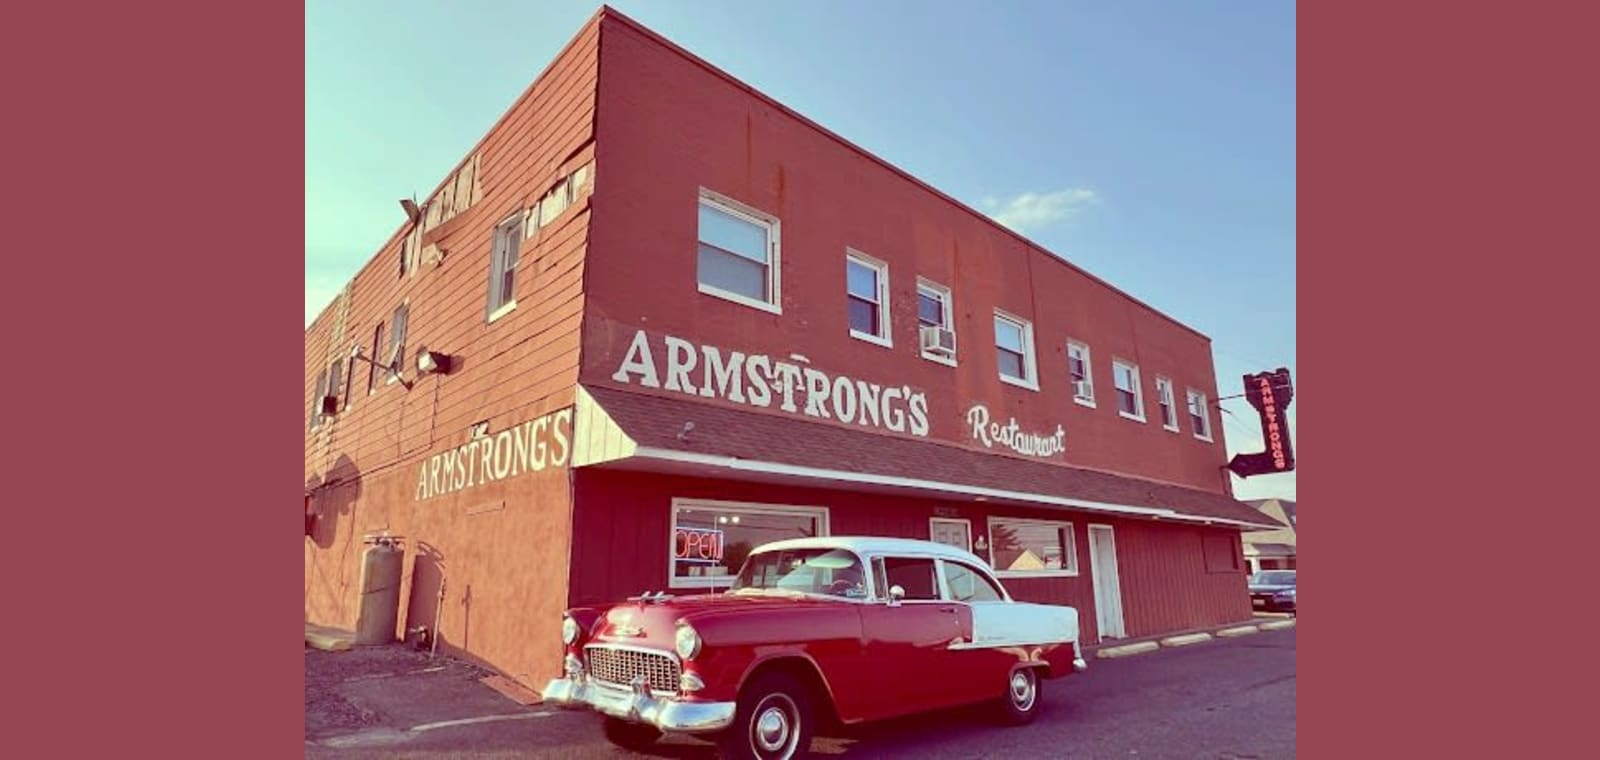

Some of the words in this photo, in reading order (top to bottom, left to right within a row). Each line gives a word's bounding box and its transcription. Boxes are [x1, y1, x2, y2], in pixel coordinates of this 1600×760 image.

[612, 330, 929, 437] ARMSTRONG'S
[967, 405, 1065, 456] Restaurant
[415, 409, 570, 500] ARMSTRONG'S
[675, 530, 722, 559] OPEN
